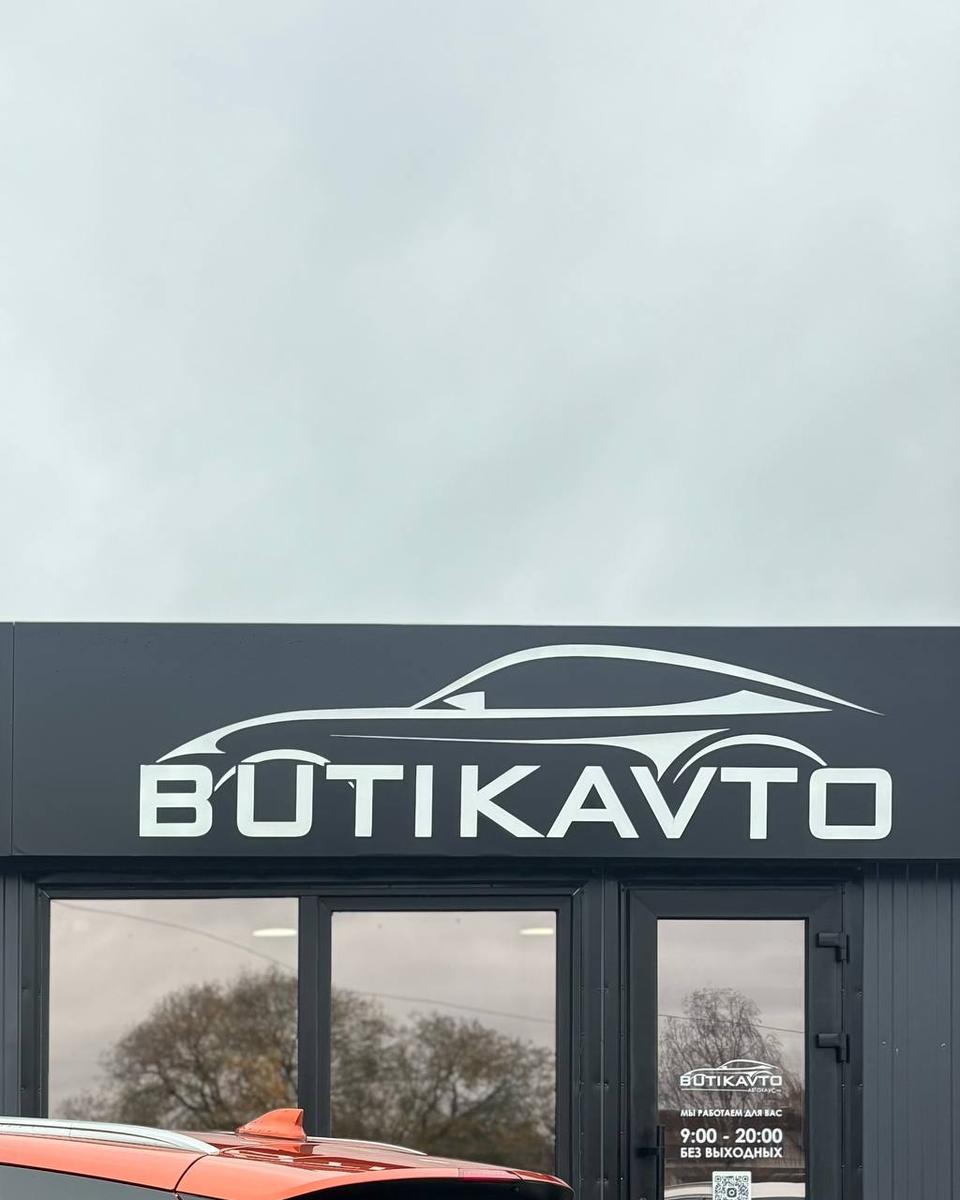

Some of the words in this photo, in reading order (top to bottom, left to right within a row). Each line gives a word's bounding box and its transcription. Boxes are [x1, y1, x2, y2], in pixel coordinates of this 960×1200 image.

[139, 763, 893, 841] BUTIKAVTO
[680, 1075, 783, 1087] BUTIKAVTO
[680, 1109, 696, 1117] МЫ
[698, 1109, 743, 1117] РАБОТАЕМ
[744, 1109, 763, 1118] ДЛЯ
[765, 1109, 783, 1117] ВАС
[680, 1128, 717, 1143] 9:00
[735, 1128, 783, 1143] 20:00
[680, 1147, 702, 1158] БЕЗ
[705, 1147, 783, 1159] ВЫХОДНЫХ
